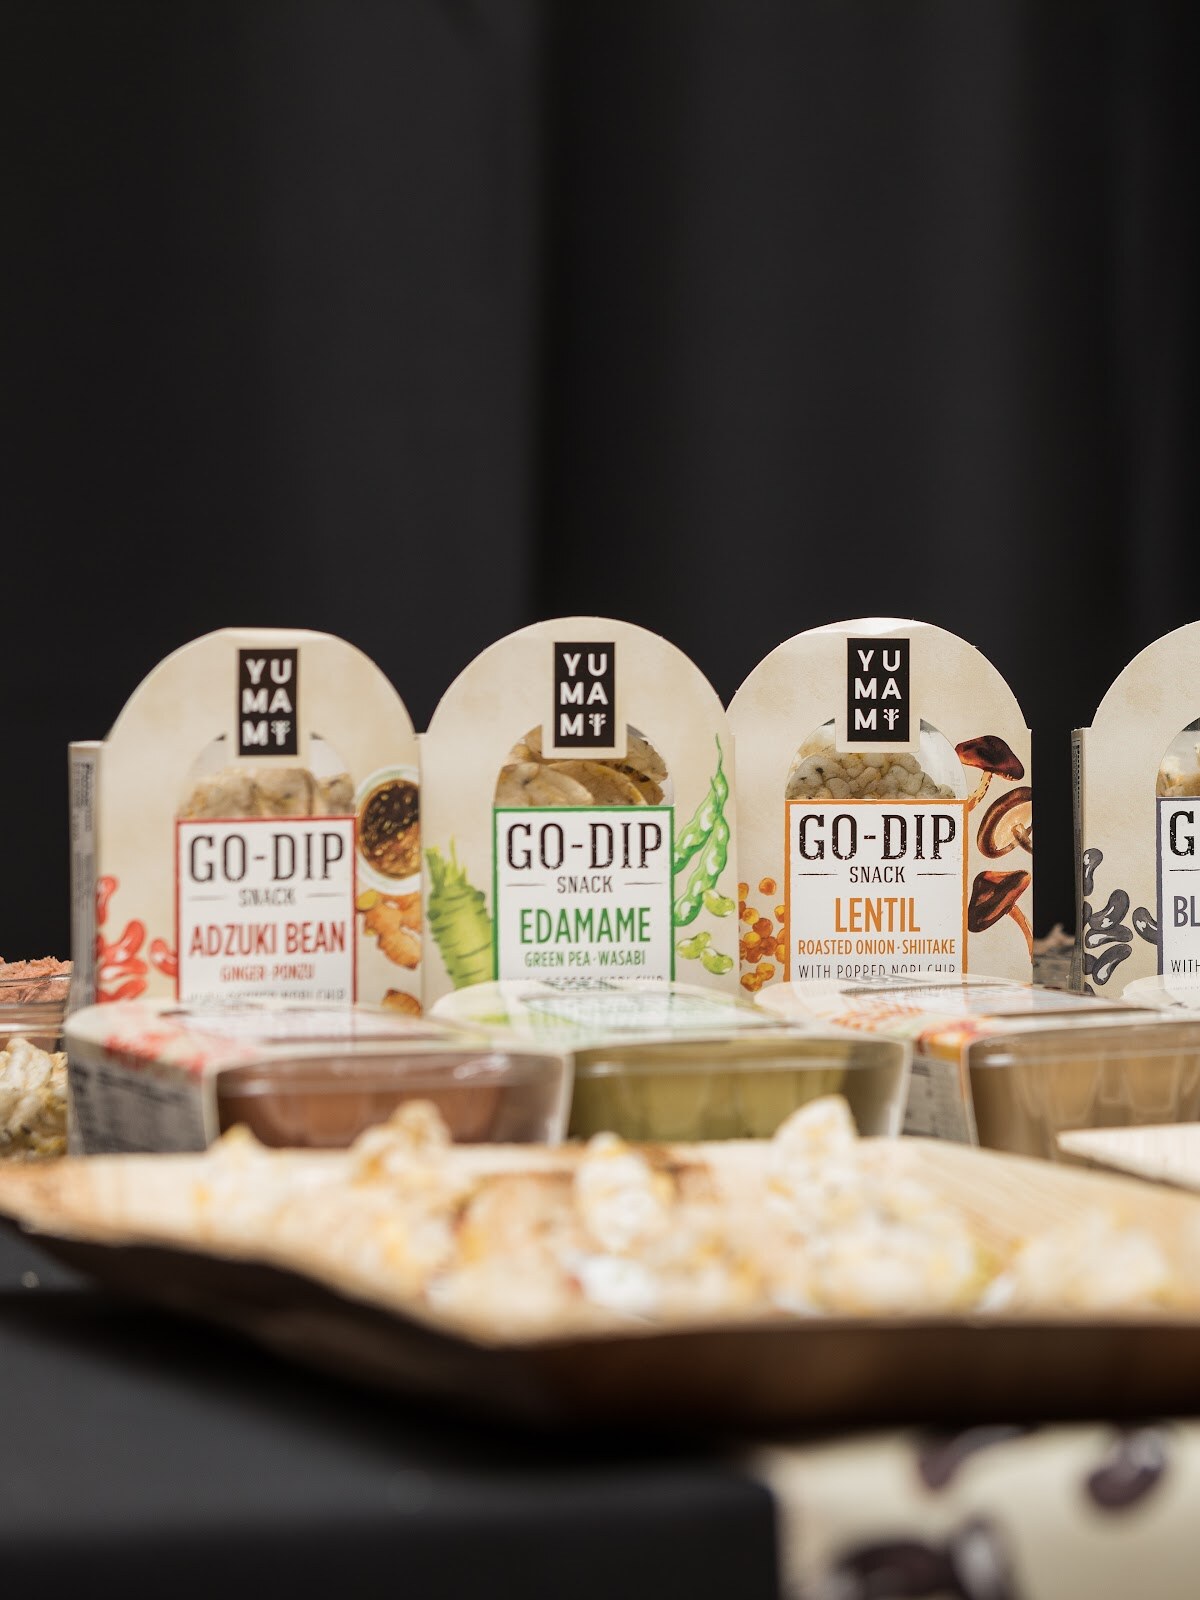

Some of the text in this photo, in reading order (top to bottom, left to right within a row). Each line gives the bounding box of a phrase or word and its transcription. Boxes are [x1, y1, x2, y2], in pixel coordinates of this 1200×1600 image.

[246, 659, 292, 684] YU
[563, 653, 608, 677] YU
[857, 650, 901, 672] YU
[560, 682, 608, 705] MA
[854, 677, 902, 700] MA
[242, 688, 293, 714] MA
[506, 822, 663, 870] GO-DIP
[798, 814, 956, 860] GO-DIP
[189, 832, 344, 882] GO-DIP
[556, 876, 613, 893] SNACK
[849, 866, 906, 884] SNACK
[239, 888, 296, 906] SNACK
[520, 907, 651, 945] EDAMAME
[835, 897, 920, 933] LENTIL
[189, 920, 345, 957] ADZUKI BEAN
[798, 939, 955, 955] ROASTED ONION SHIITAKE
[524, 950, 646, 967] GREEN PEA WASABI
[221, 965, 265, 982] GINGER
[799, 964, 831, 978] WITH
[837, 964, 885, 978] POPPED
